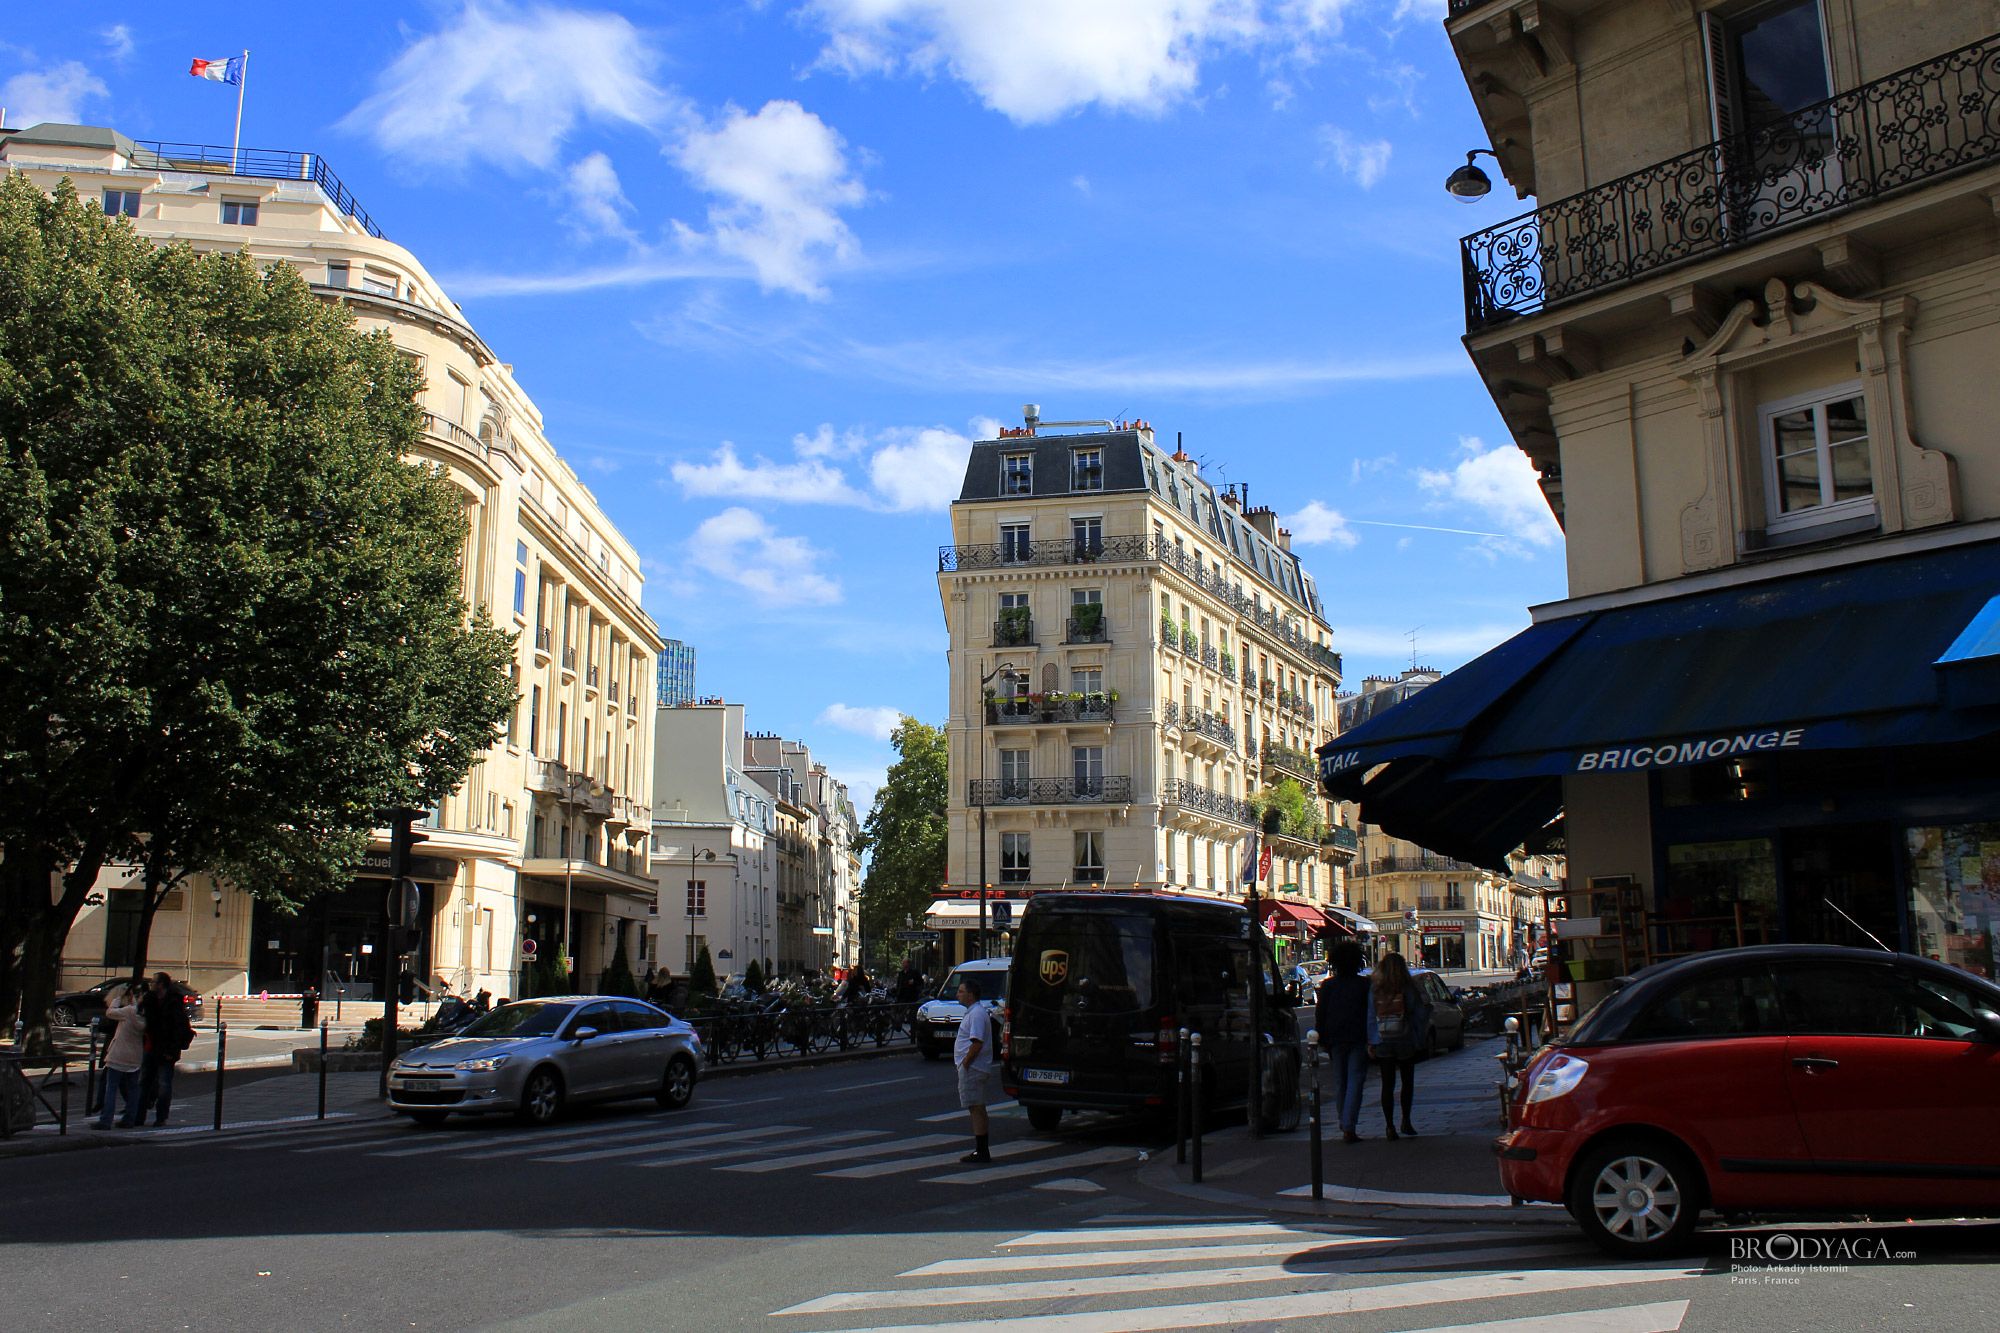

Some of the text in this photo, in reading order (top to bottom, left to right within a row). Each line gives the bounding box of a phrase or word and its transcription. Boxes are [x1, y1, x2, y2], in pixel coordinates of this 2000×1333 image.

[1576, 728, 1805, 771] BRICOMONGE
[356, 856, 392, 868] ccuei
[1041, 960, 1066, 980] ups
